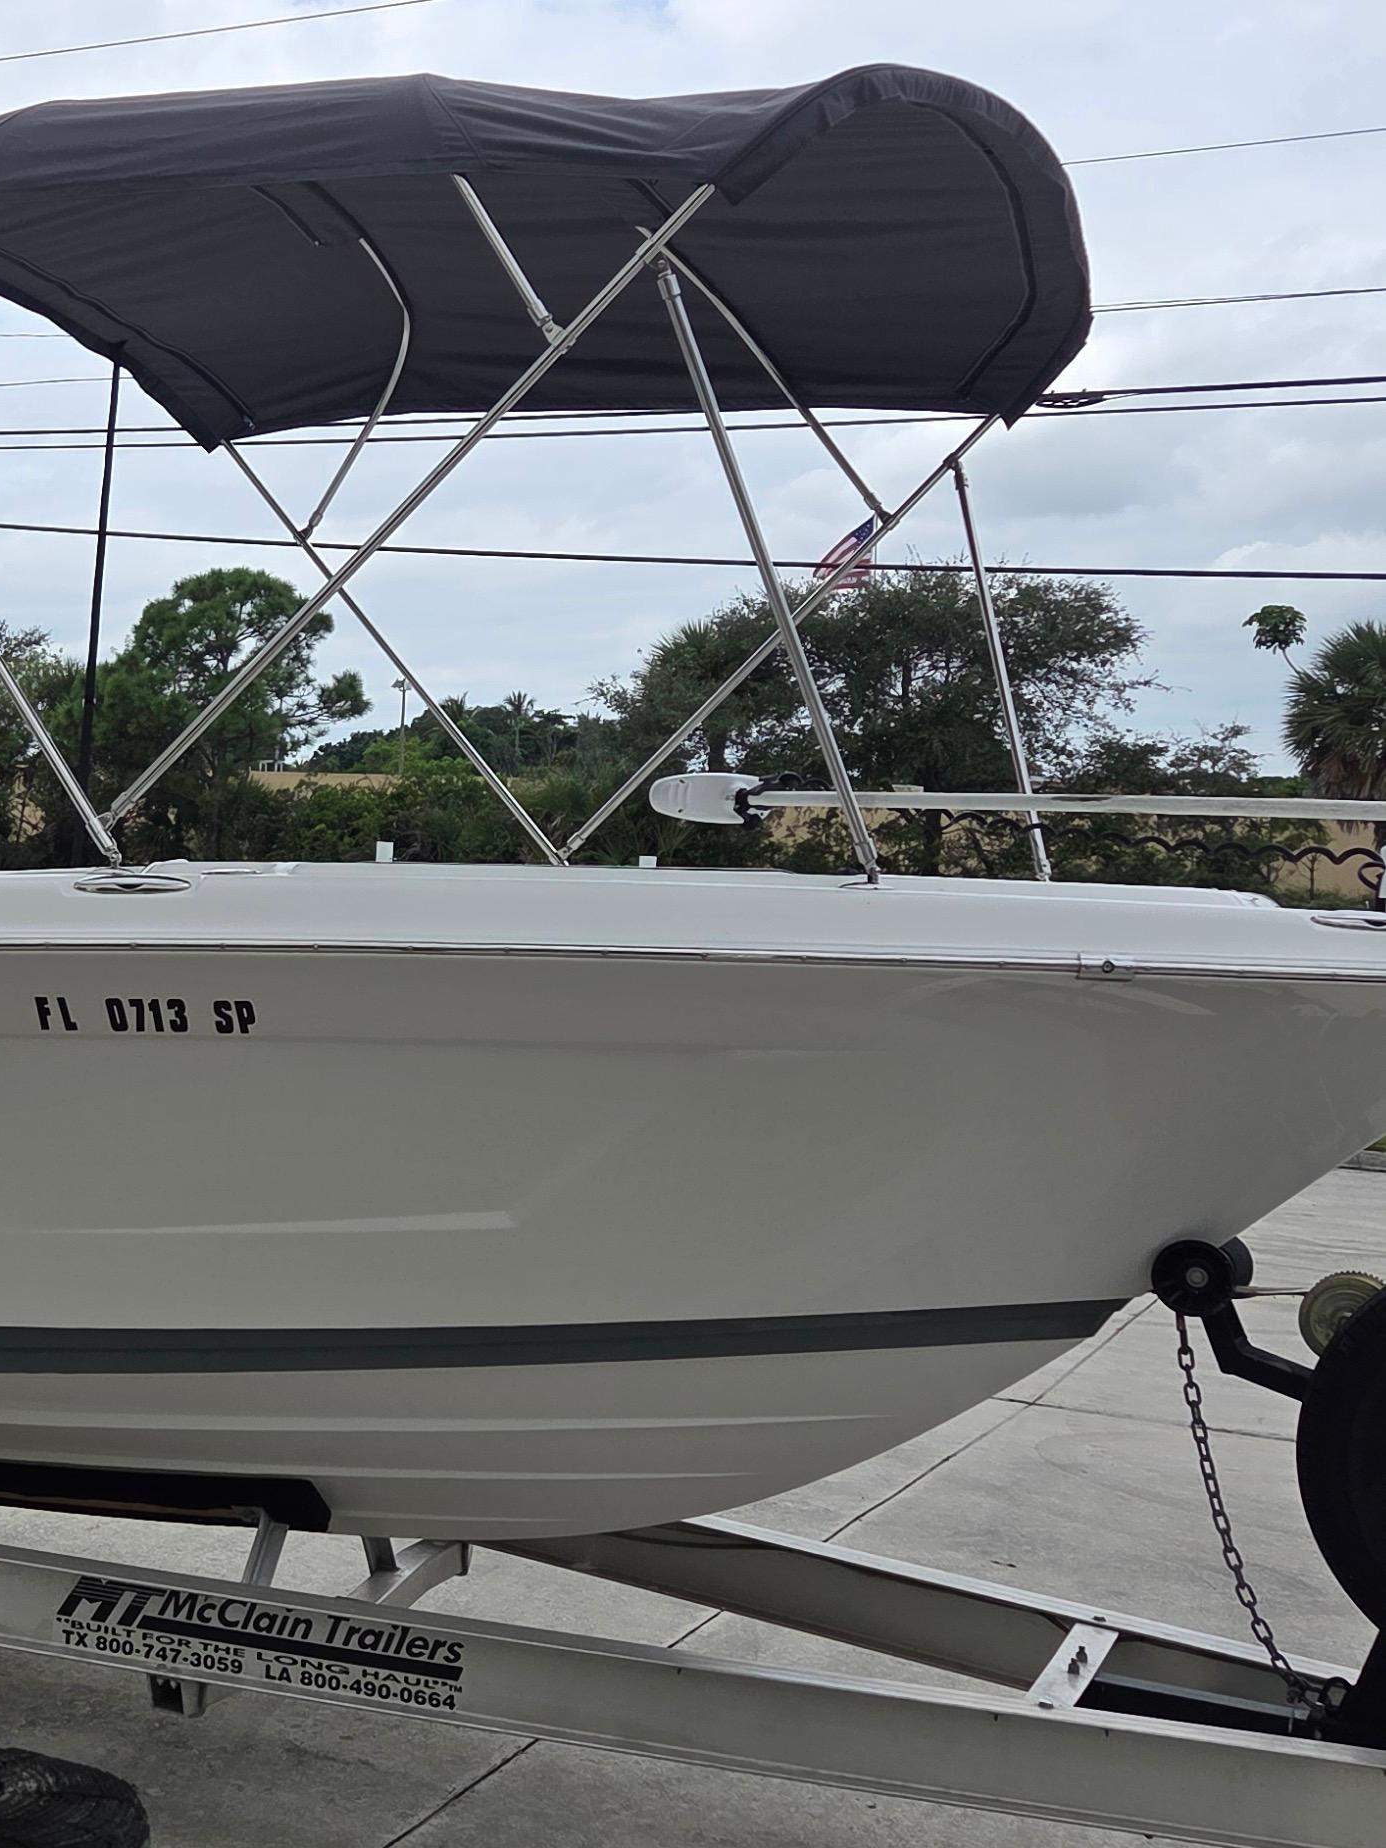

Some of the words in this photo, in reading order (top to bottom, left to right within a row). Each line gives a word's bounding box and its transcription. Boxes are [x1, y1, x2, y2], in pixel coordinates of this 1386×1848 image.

[34, 996, 79, 1031] FL
[104, 997, 189, 1033] 0713
[213, 1000, 256, 1034] SP
[157, 1589, 314, 1640] McClain
[325, 1614, 465, 1664] Trailers
[61, 1628, 89, 1649] TX
[264, 1663, 293, 1684] LA
[141, 1631, 193, 1649] FOR
[198, 1641, 246, 1658] THE
[256, 1651, 350, 1676] LONG
